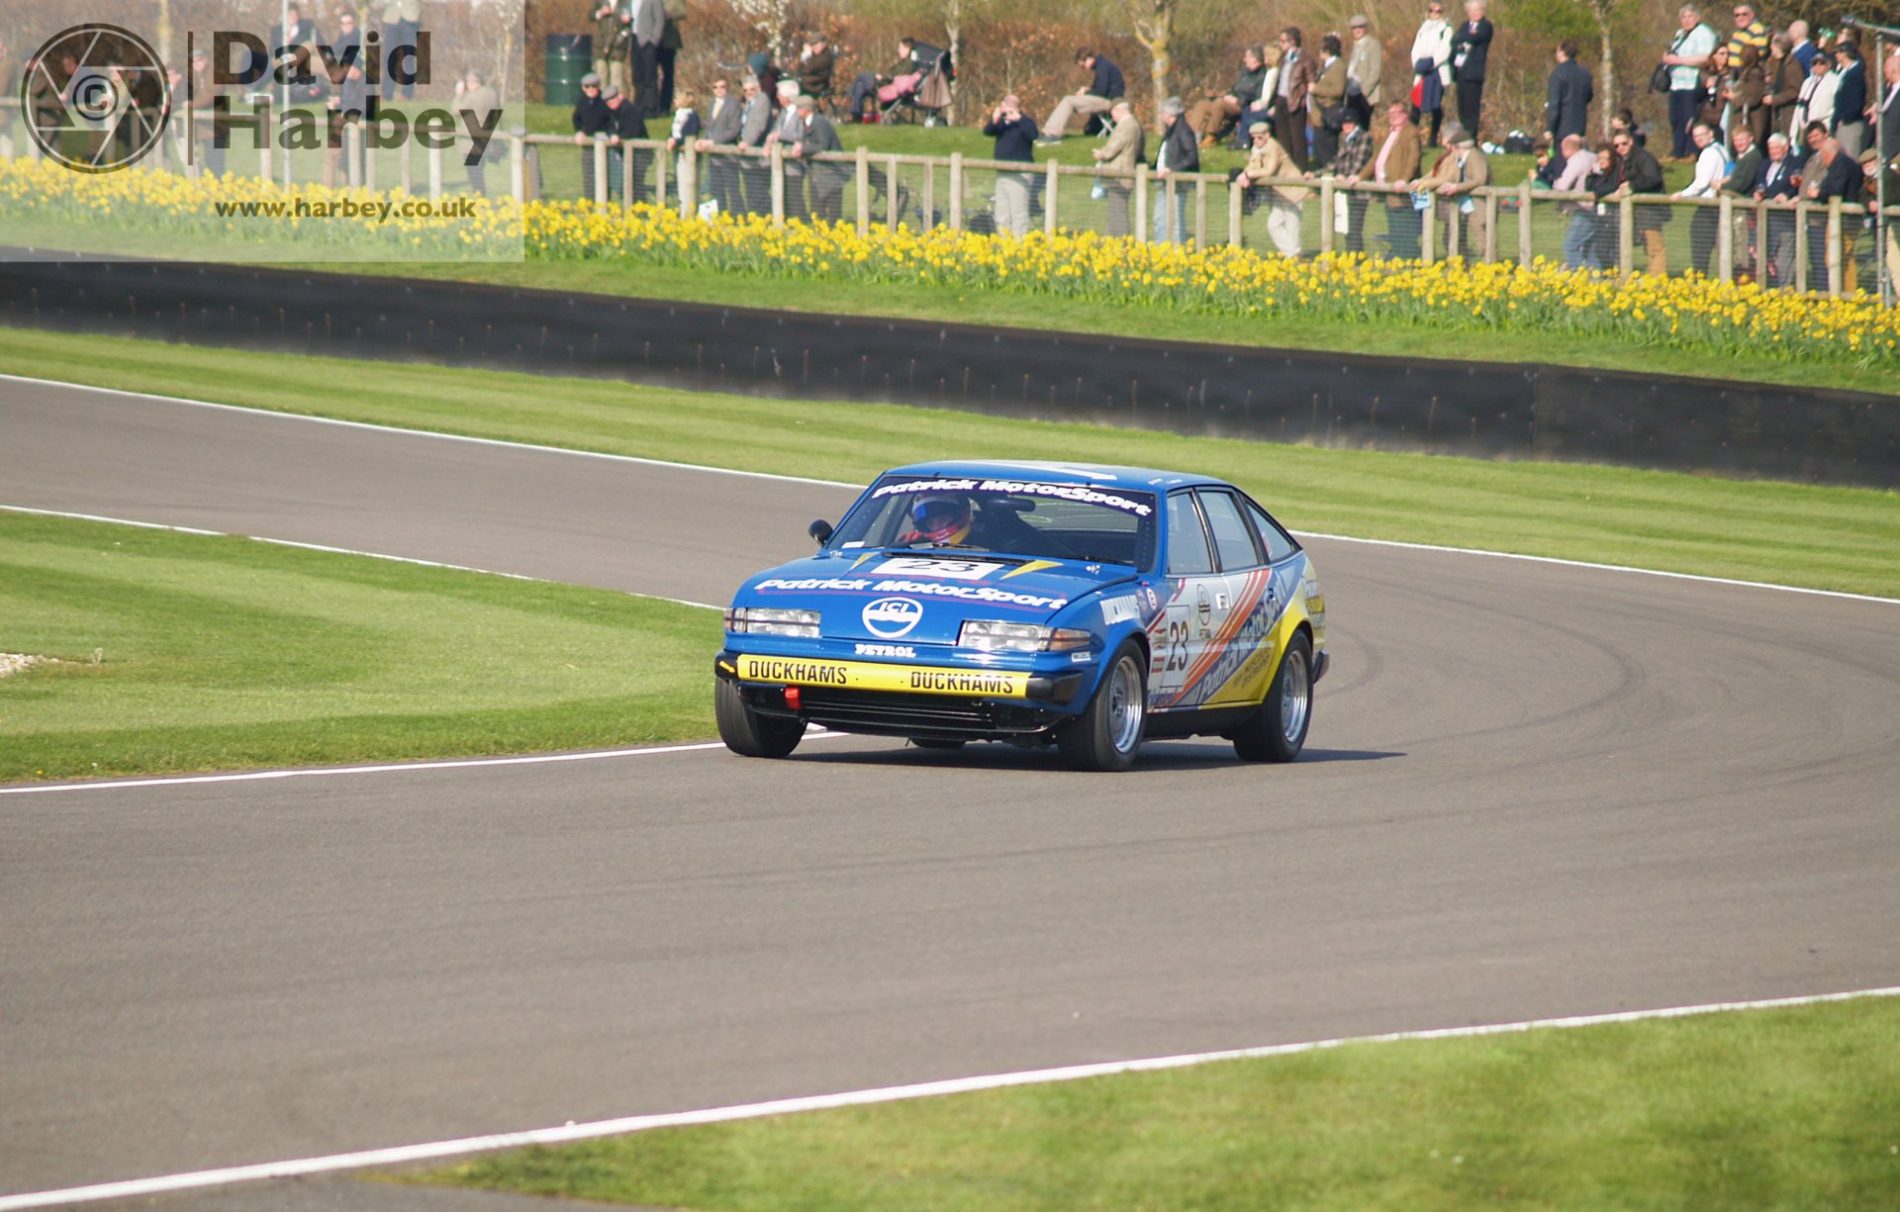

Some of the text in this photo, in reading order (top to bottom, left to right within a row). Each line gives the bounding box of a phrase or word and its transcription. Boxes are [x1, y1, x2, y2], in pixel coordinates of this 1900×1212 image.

[877, 601, 911, 613] ICI
[854, 643, 916, 659] PETROL
[1167, 621, 1188, 671] 23
[748, 660, 1014, 696] DUCKHAMS DUCKHAMS
